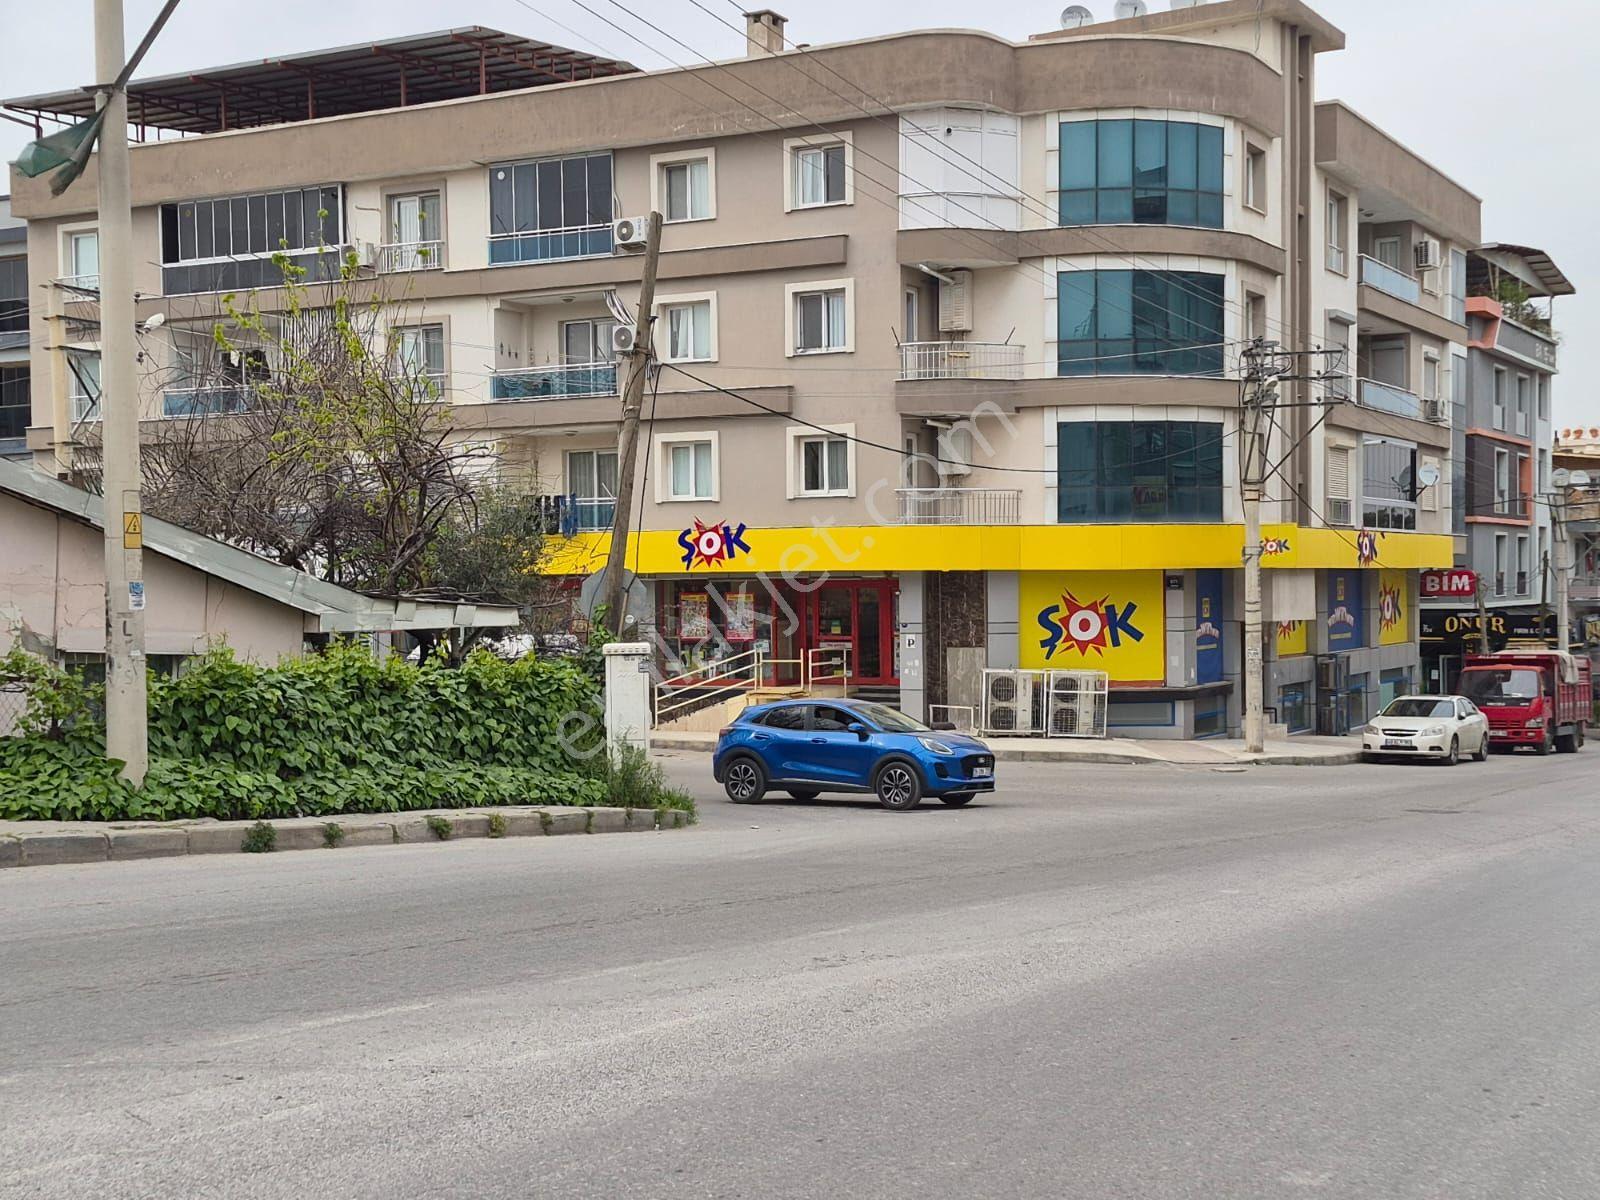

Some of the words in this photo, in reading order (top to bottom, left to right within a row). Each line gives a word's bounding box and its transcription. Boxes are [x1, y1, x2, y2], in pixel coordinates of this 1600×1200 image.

[677, 522, 751, 571] ŞOK
[1426, 571, 1470, 592] BİM
[1037, 601, 1144, 660] ŞOK
[1445, 616, 1506, 634] ONUR
